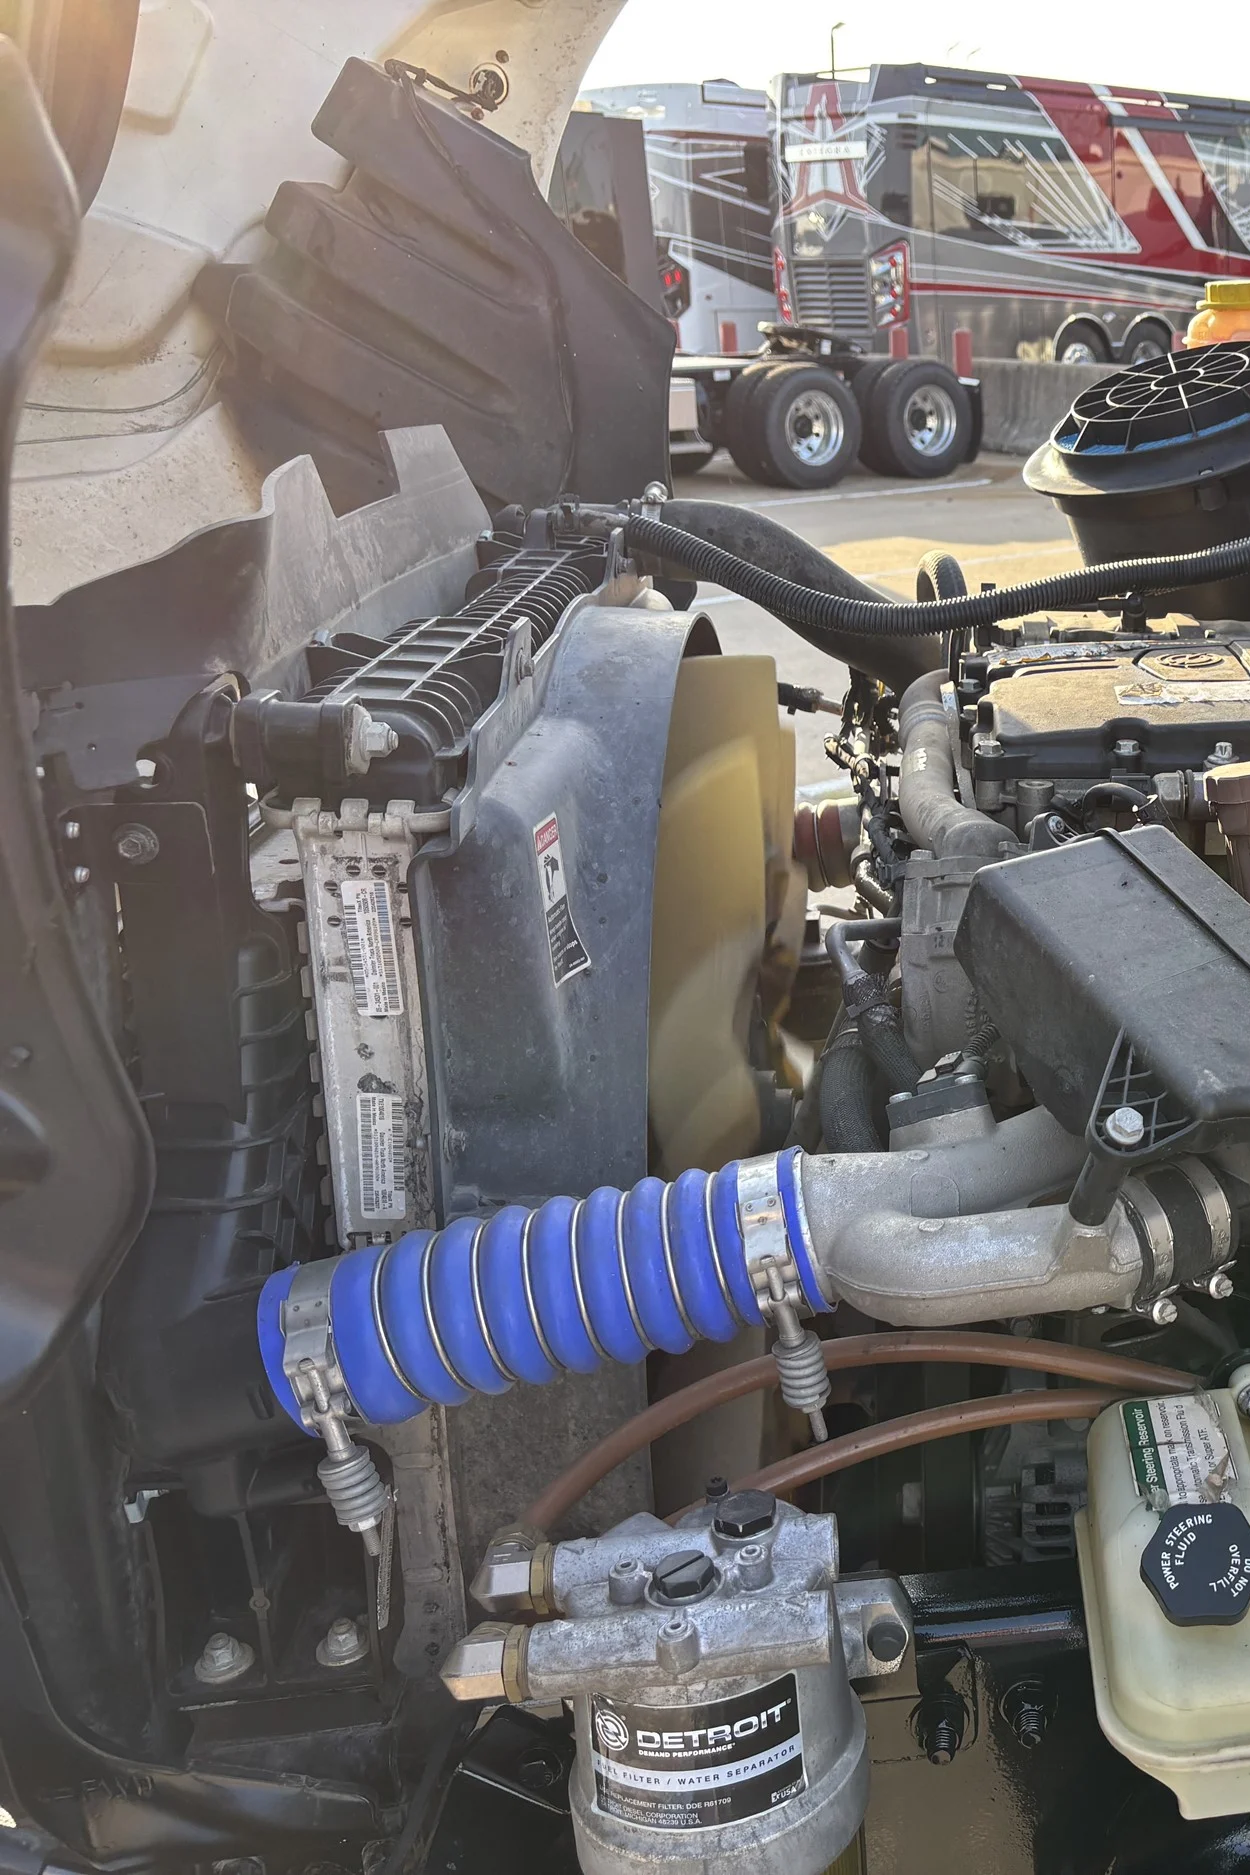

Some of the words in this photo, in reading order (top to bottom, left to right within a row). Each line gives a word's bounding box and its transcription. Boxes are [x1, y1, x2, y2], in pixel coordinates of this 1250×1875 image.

[540, 824, 558, 847] DANGER
[1132, 1408, 1149, 1447] Reservoir
[1156, 1401, 1170, 1429] reservoir.
[1164, 1429, 1173, 1438] on
[1180, 1420, 1195, 1462] Transmission
[1142, 1446, 1158, 1484] Steering
[1203, 1442, 1215, 1461] Super
[1169, 1455, 1187, 1491] appropriate
[1165, 1514, 1213, 1546] STEERING
[1175, 1531, 1196, 1566] FLUID
[1161, 1551, 1179, 1590] POWER
[1208, 1544, 1241, 1592] OVERFILL
[1230, 1576, 1248, 1597] NOT
[636, 1701, 787, 1749] DETROIT
[623, 1772, 660, 1785] FILTER
[677, 1774, 720, 1786] WATER
[726, 1745, 796, 1779] SEPARATOR
[638, 1749, 671, 1759] DEMAND
[672, 1743, 734, 1758] PERFORMANCE
[623, 1806, 643, 1817] DIESEL
[645, 1811, 699, 1821] CORPORATION
[658, 1802, 685, 1811] FILTER:
[686, 1802, 703, 1810] DDE
[704, 1797, 732, 1808] R61709
[658, 1817, 680, 1825] 48239
[682, 1818, 703, 1826] U.S.A.
